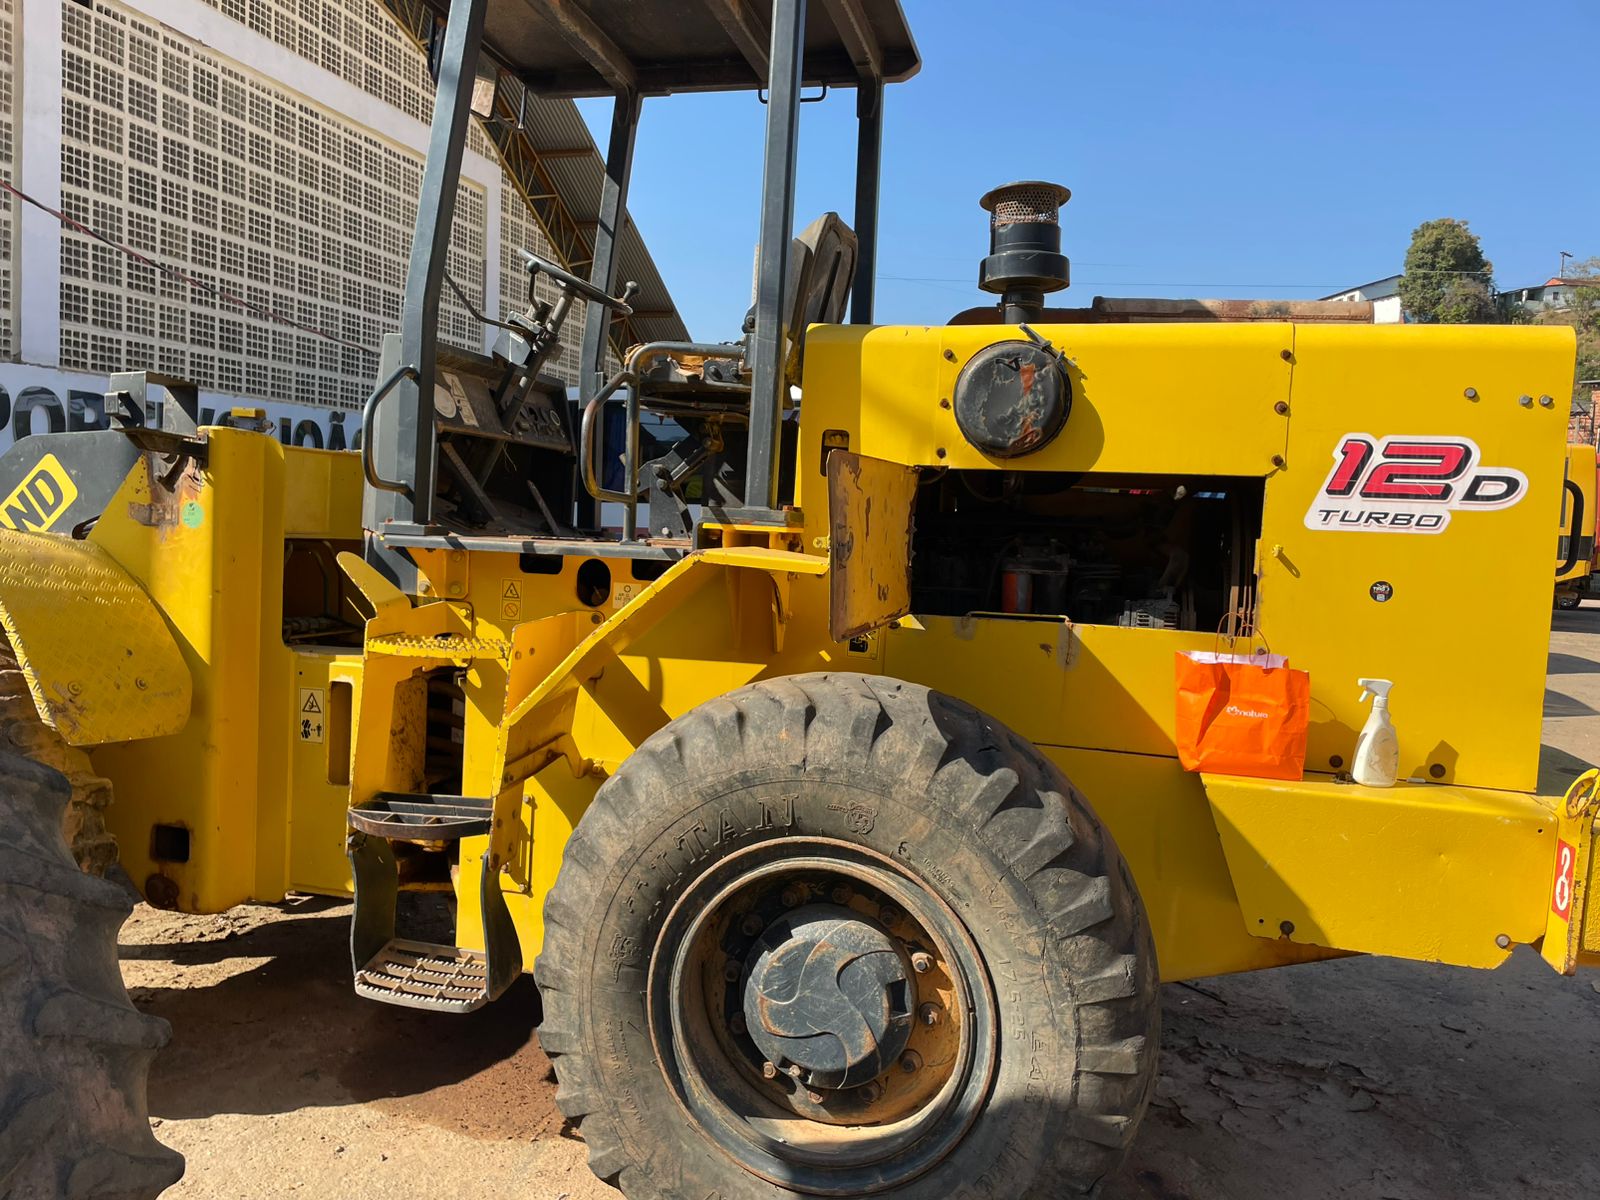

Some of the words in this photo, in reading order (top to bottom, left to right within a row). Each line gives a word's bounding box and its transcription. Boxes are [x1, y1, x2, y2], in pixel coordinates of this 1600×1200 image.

[0, 469, 64, 531] ND
[1319, 509, 1443, 527] TURBO
[622, 793, 800, 921] TITAN
[998, 958, 1026, 1041] 17.5-25
